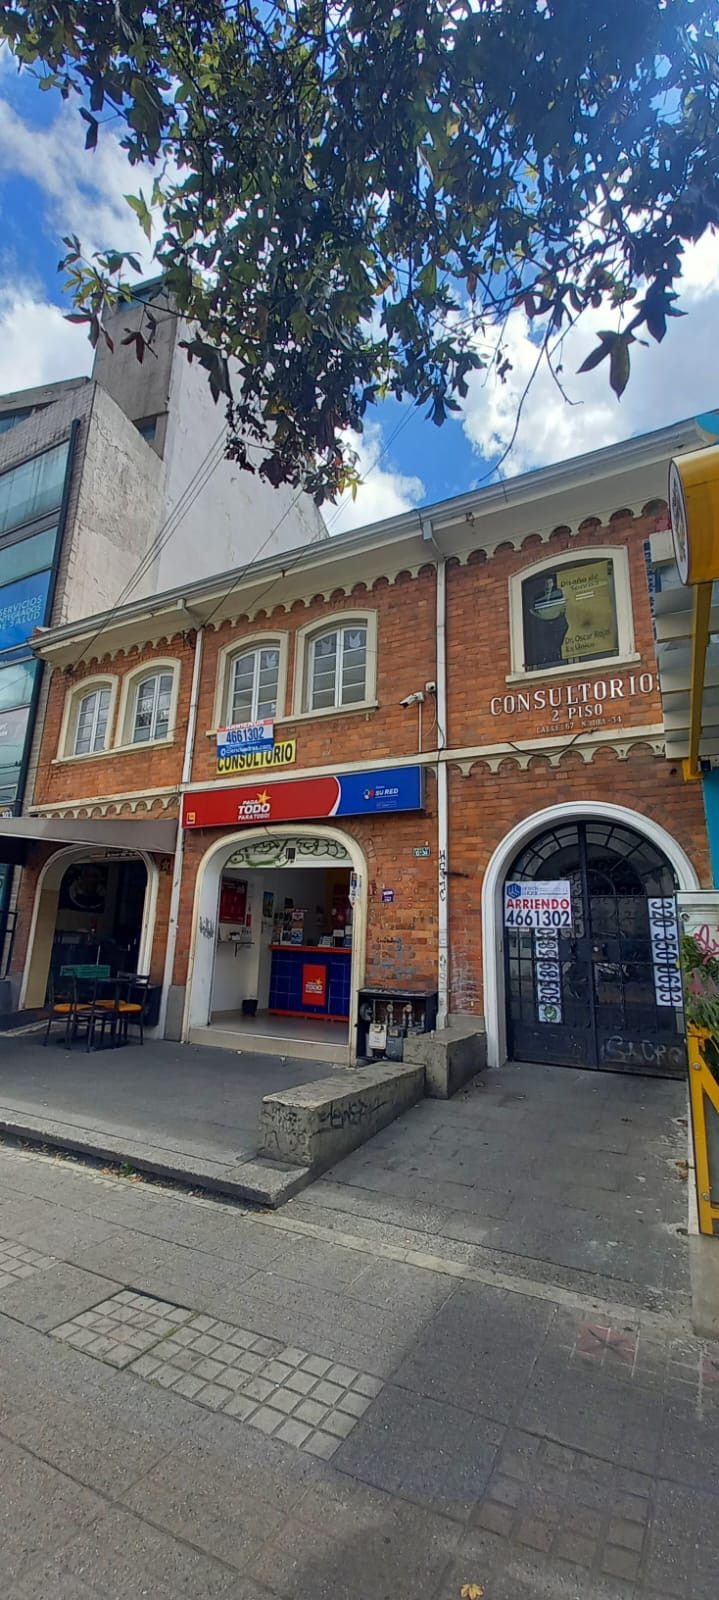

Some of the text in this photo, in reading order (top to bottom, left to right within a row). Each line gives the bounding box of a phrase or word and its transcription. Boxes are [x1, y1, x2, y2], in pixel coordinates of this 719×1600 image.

[490, 672, 660, 716] CONSULTORIO
[552, 703, 603, 722] 2 PISO
[226, 726, 265, 743] 4661302
[536, 723, 561, 734] CALLE
[217, 742, 293, 772] CONSULTORIO
[375, 789, 384, 797] SU
[384, 787, 399, 795] RED
[238, 803, 271, 815] TODO
[506, 898, 570, 910] ARRIENDO
[506, 910, 571, 927] 4661302
[650, 901, 675, 928] 320
[654, 933, 678, 960] 350
